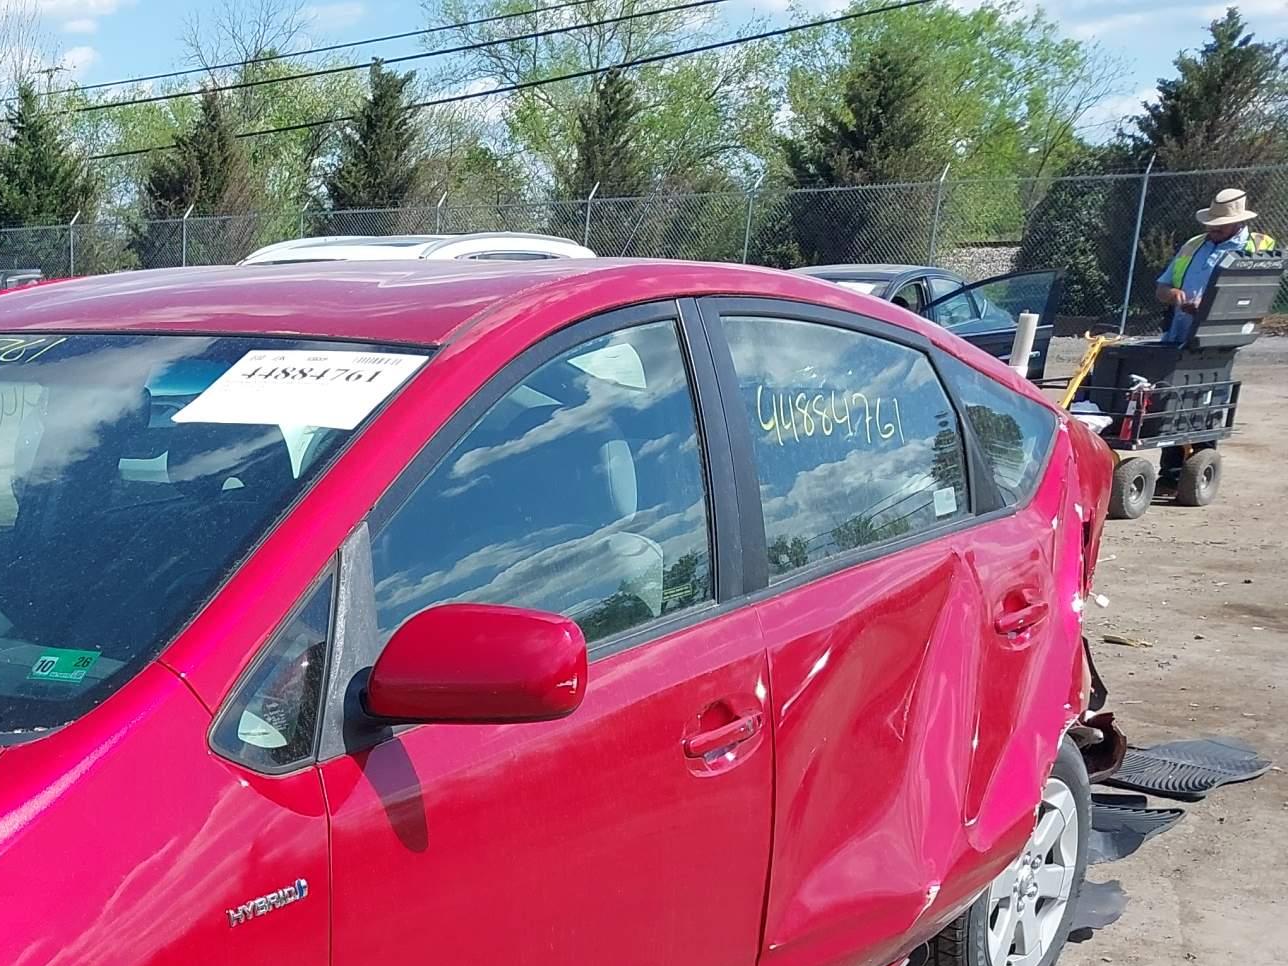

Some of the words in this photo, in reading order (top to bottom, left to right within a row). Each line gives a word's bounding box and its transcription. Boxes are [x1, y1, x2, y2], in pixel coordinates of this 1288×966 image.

[242, 366, 383, 383] 44884761
[757, 385, 905, 446] 44884761
[35, 659, 55, 673] 10
[74, 656, 93, 668] 26
[226, 886, 297, 927] HYBRID
